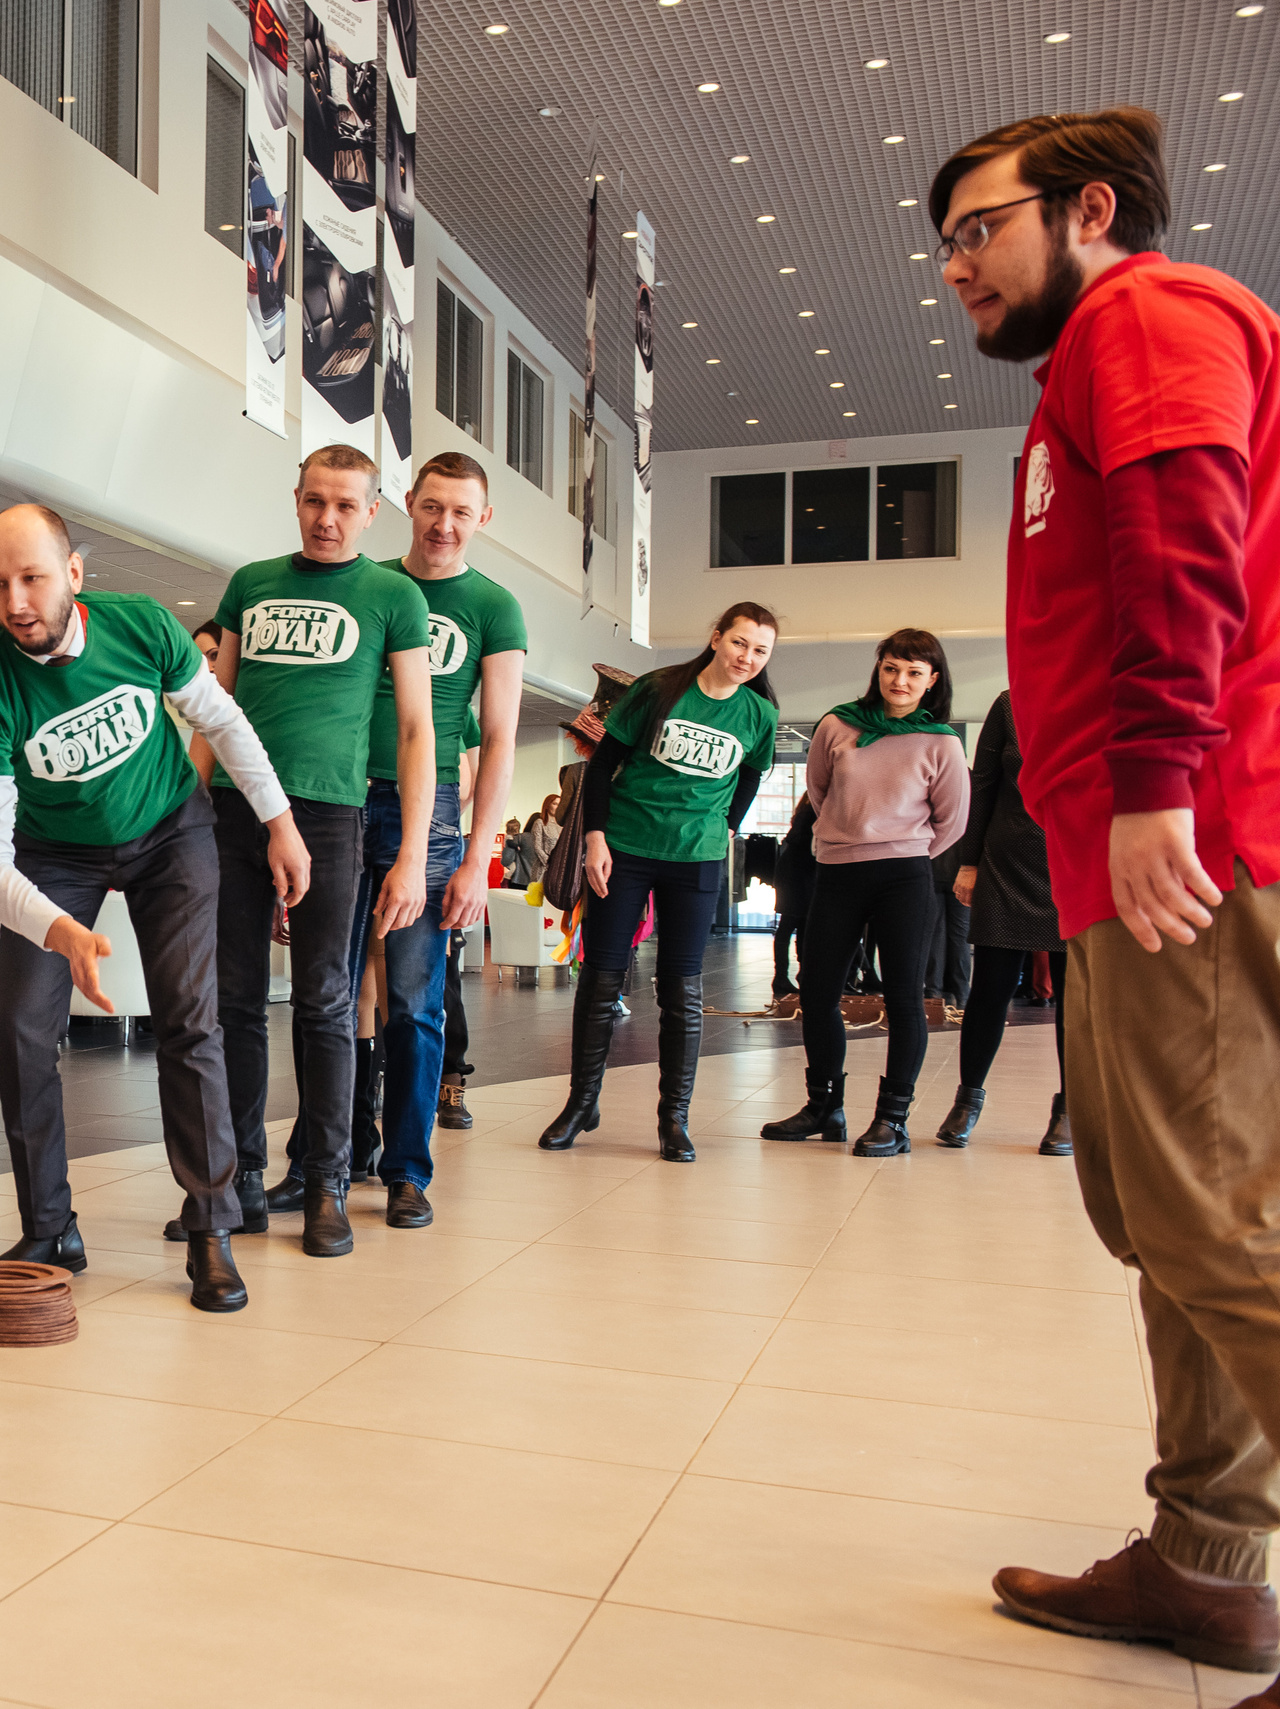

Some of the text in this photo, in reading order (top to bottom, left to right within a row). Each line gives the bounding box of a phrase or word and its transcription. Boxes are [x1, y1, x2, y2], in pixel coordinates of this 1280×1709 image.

[241, 606, 360, 661] BOYARD
[267, 606, 326, 621] FORT
[24, 690, 156, 779] BOYARD
[56, 699, 118, 741] FORT
[679, 726, 724, 745] FORT
[650, 722, 743, 775] BOYARD
